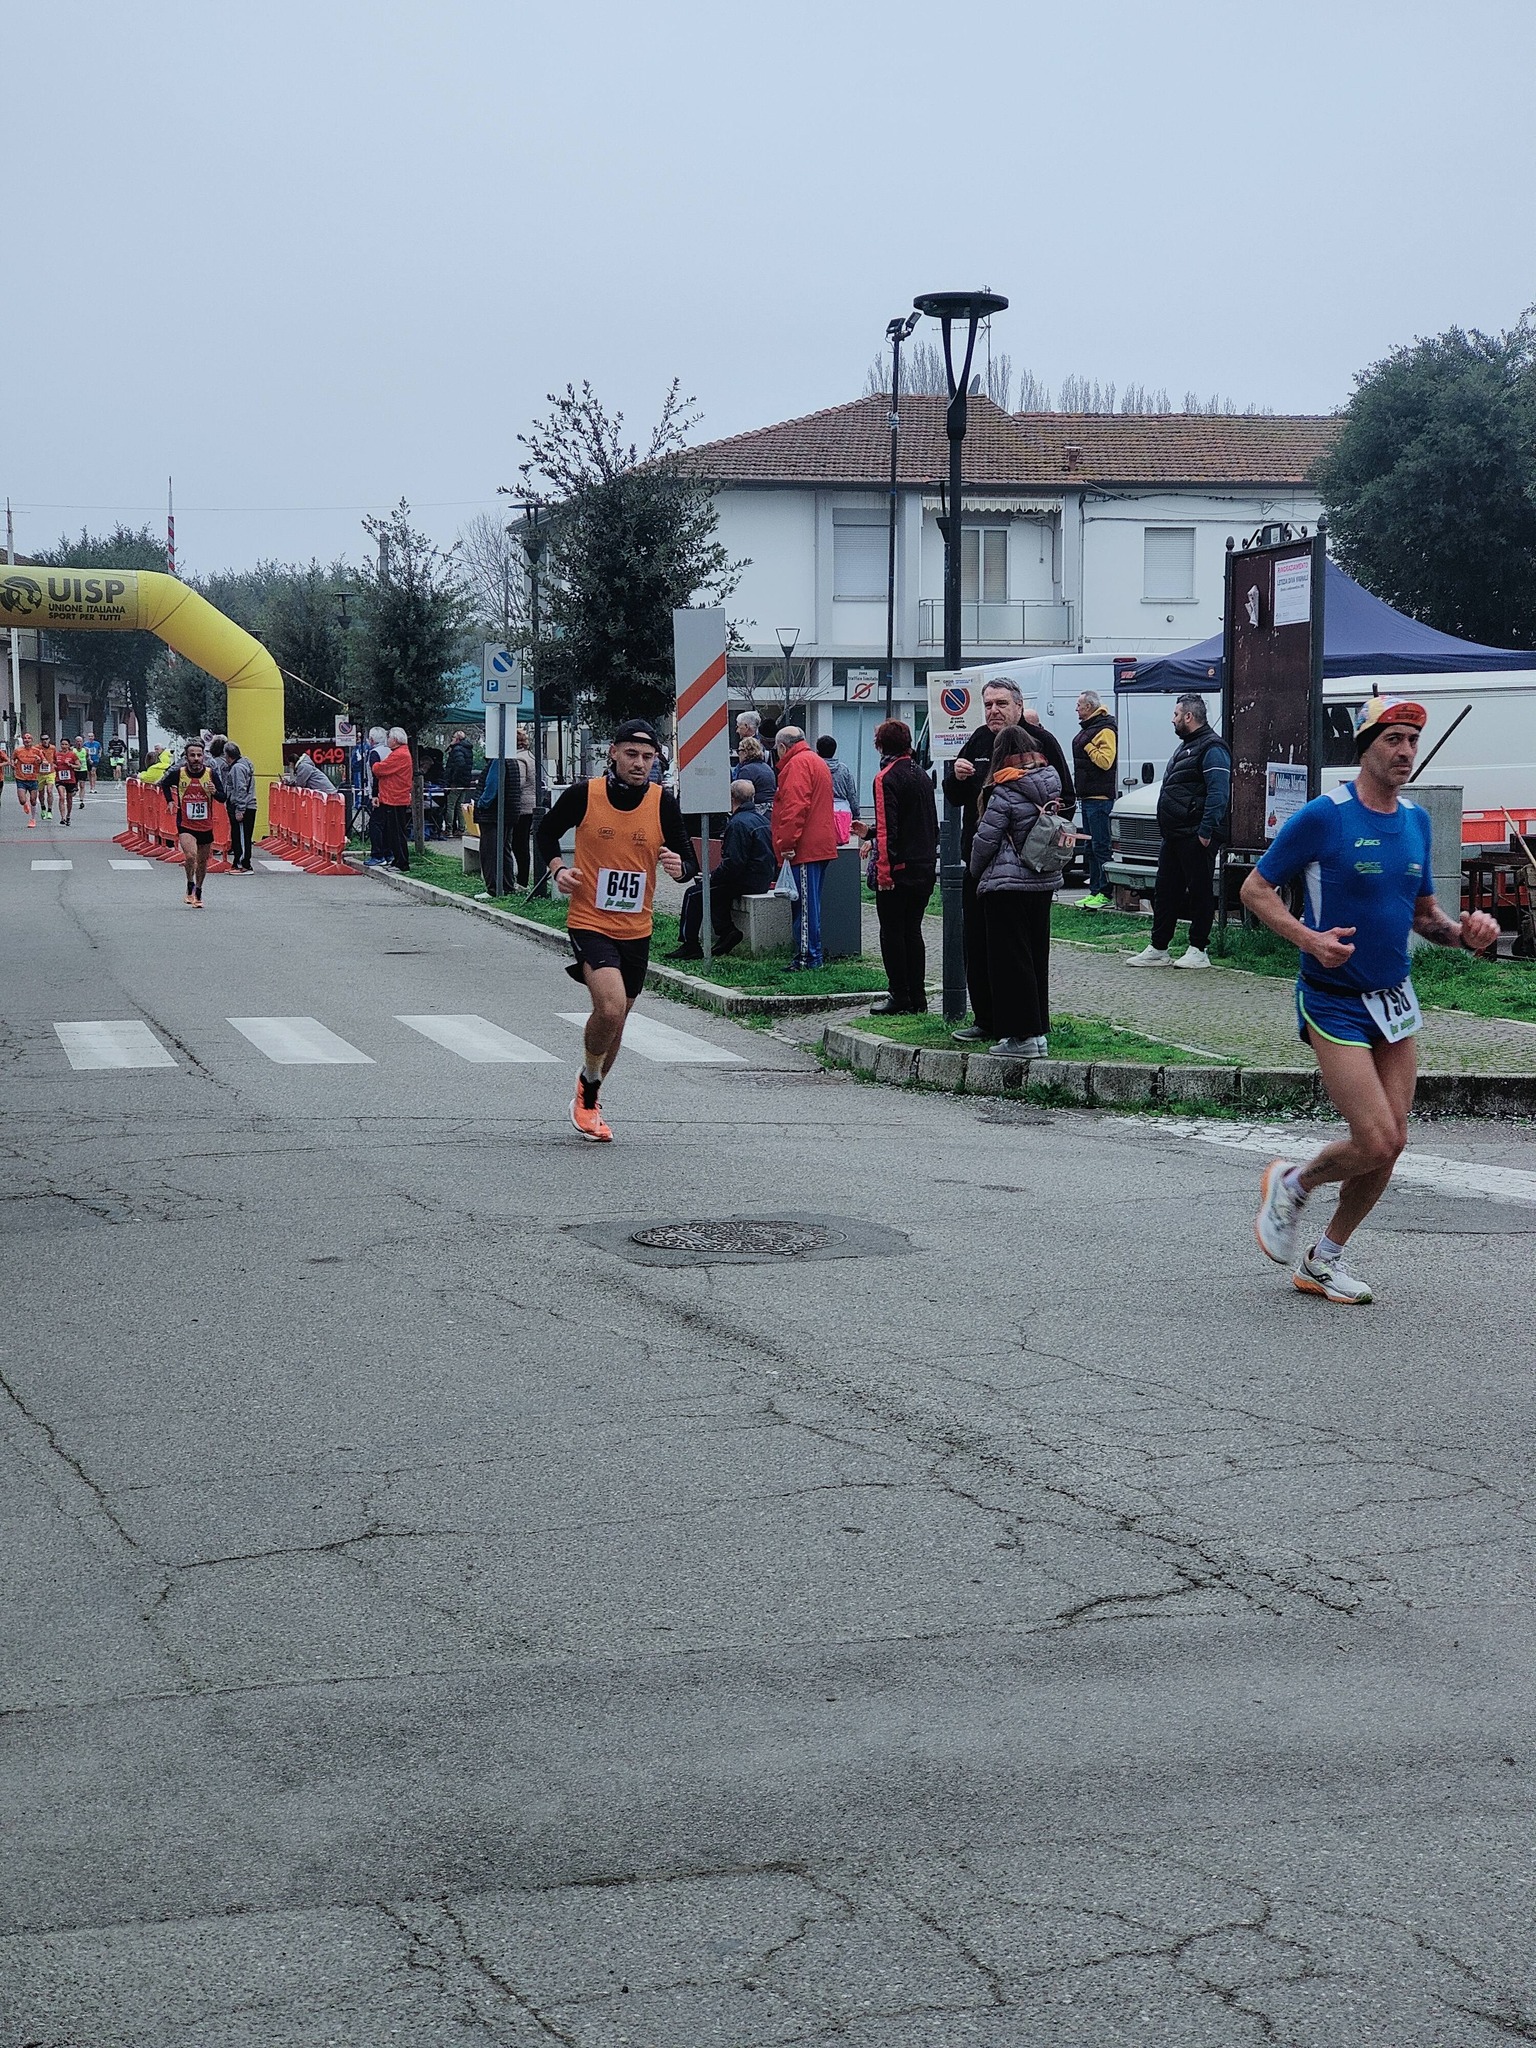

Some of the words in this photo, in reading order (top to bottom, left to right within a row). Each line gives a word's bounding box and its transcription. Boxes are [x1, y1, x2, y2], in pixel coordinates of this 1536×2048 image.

[48, 577, 125, 604] UISP
[48, 603, 83, 613] UNIONE
[86, 605, 126, 614] ITALIANA
[48, 612, 76, 620] SPORT
[80, 613, 95, 621] PER
[489, 681, 497, 691] P
[192, 803, 205, 814] 735
[607, 871, 641, 899] 645
